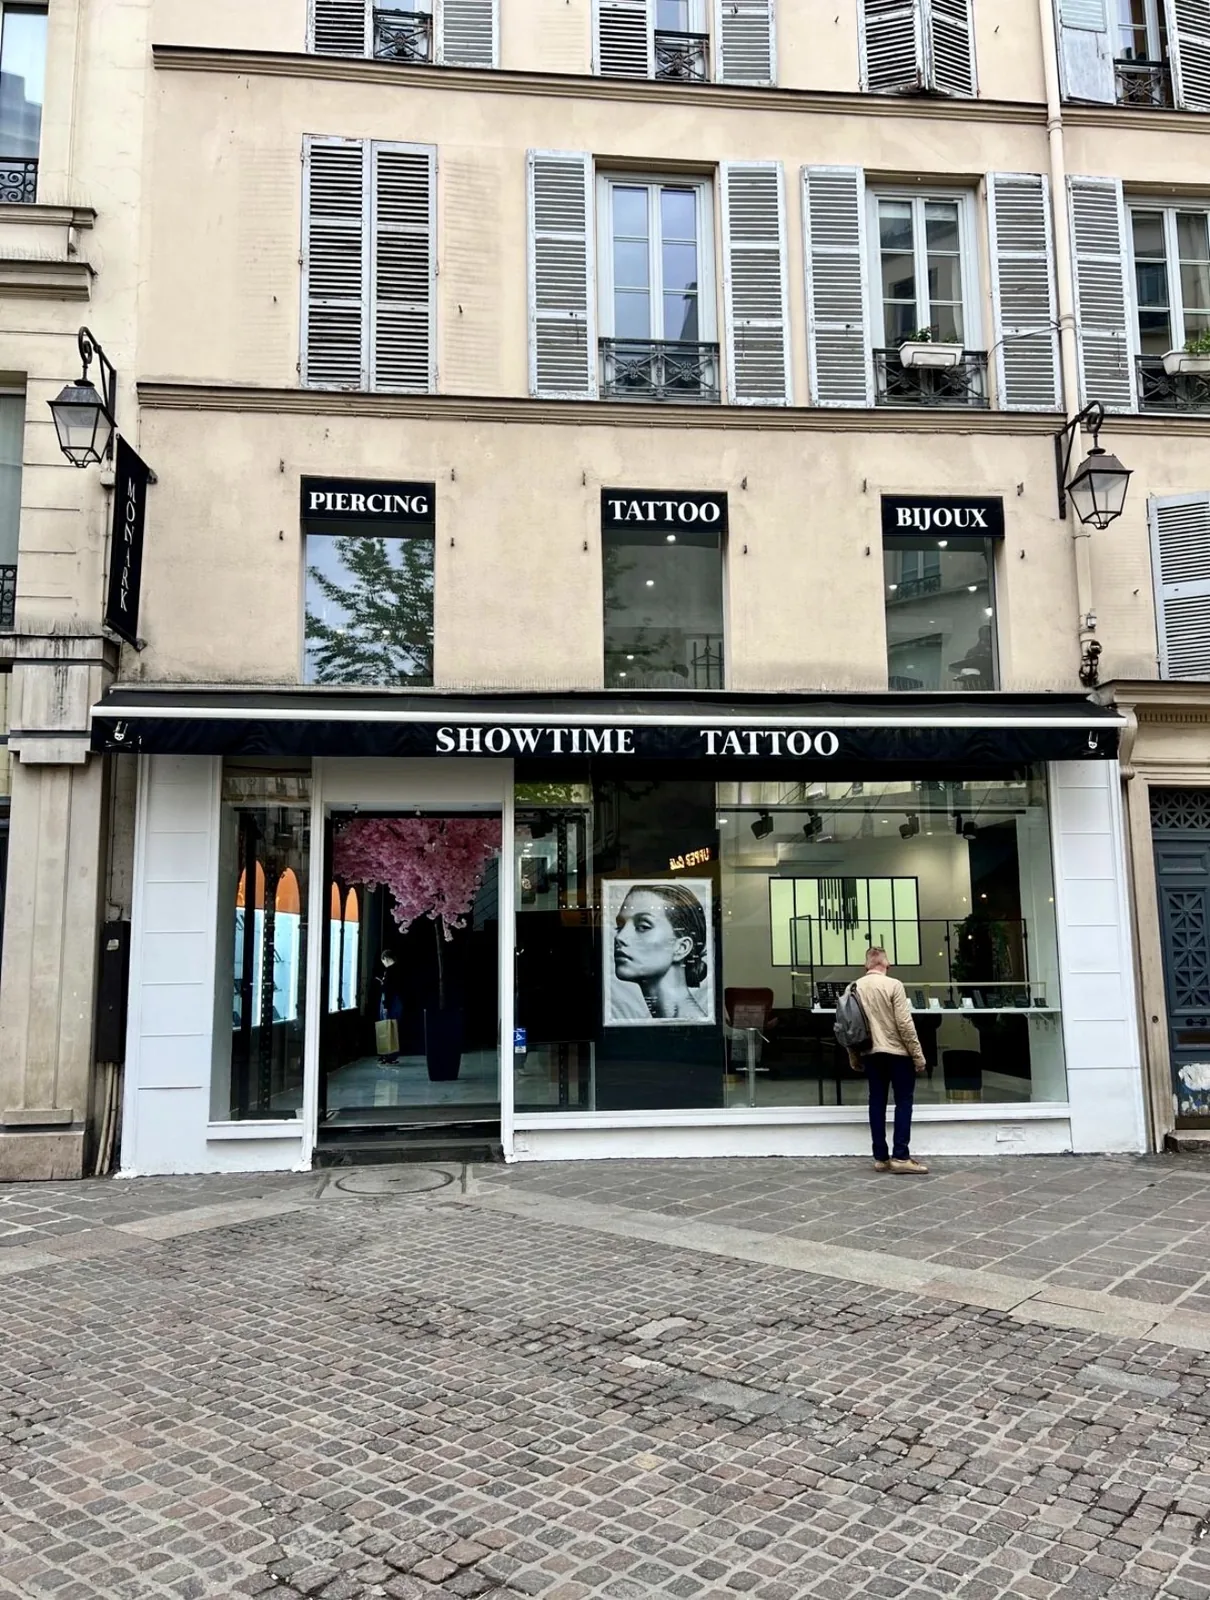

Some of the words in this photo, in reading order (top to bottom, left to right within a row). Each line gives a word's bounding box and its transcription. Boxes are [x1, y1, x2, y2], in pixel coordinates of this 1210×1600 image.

[309, 491, 429, 515] PIERCING
[608, 500, 721, 523] TATTOO
[895, 507, 989, 531] BIJOUX
[435, 726, 636, 756] SHOWTIME
[699, 728, 840, 757] TATTOO
